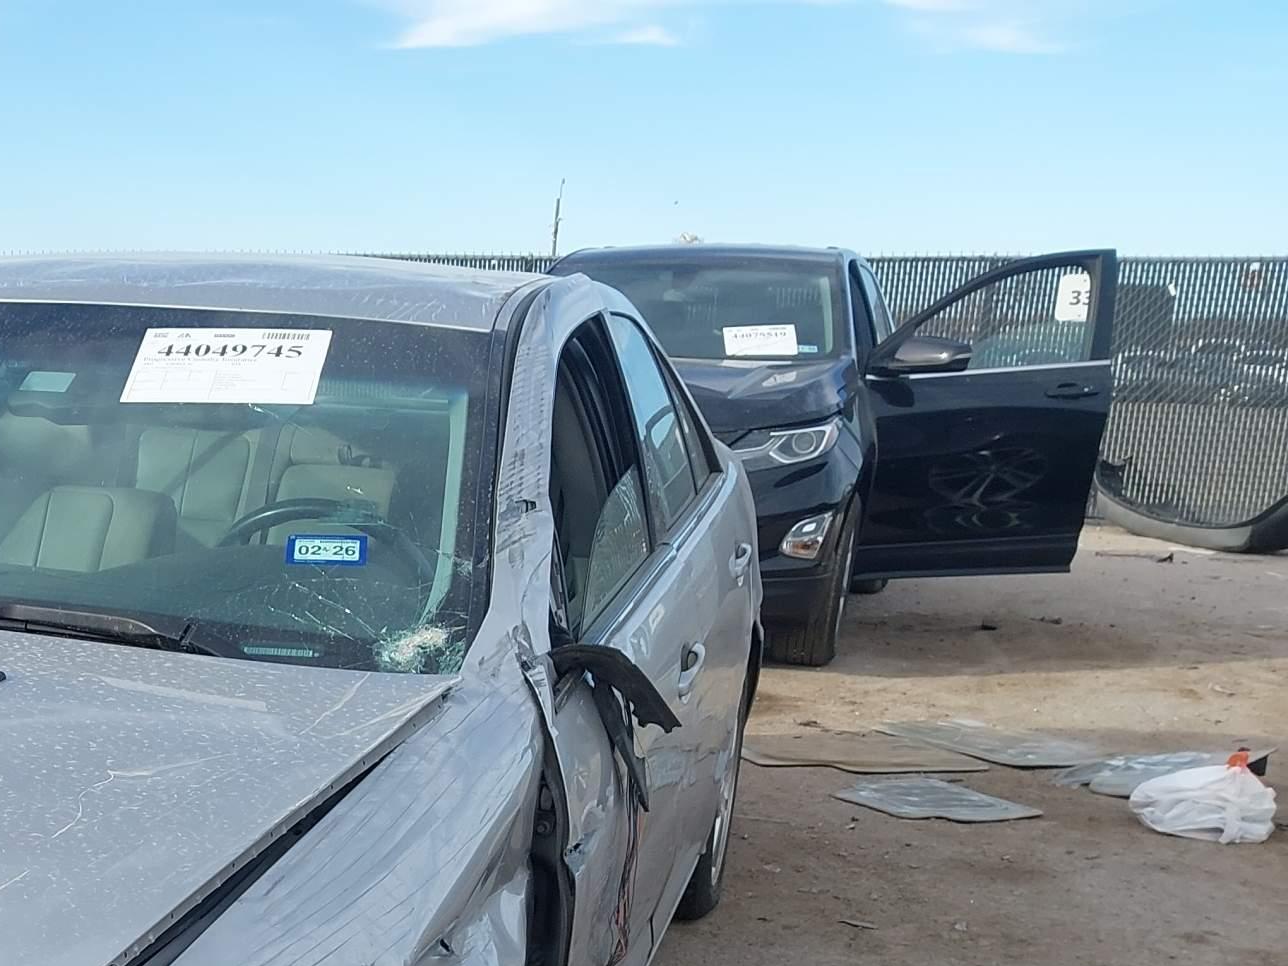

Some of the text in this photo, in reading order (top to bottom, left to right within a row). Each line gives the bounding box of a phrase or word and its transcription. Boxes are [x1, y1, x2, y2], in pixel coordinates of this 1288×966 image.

[157, 343, 304, 359] 44049745
[298, 545, 356, 556] 02 26
